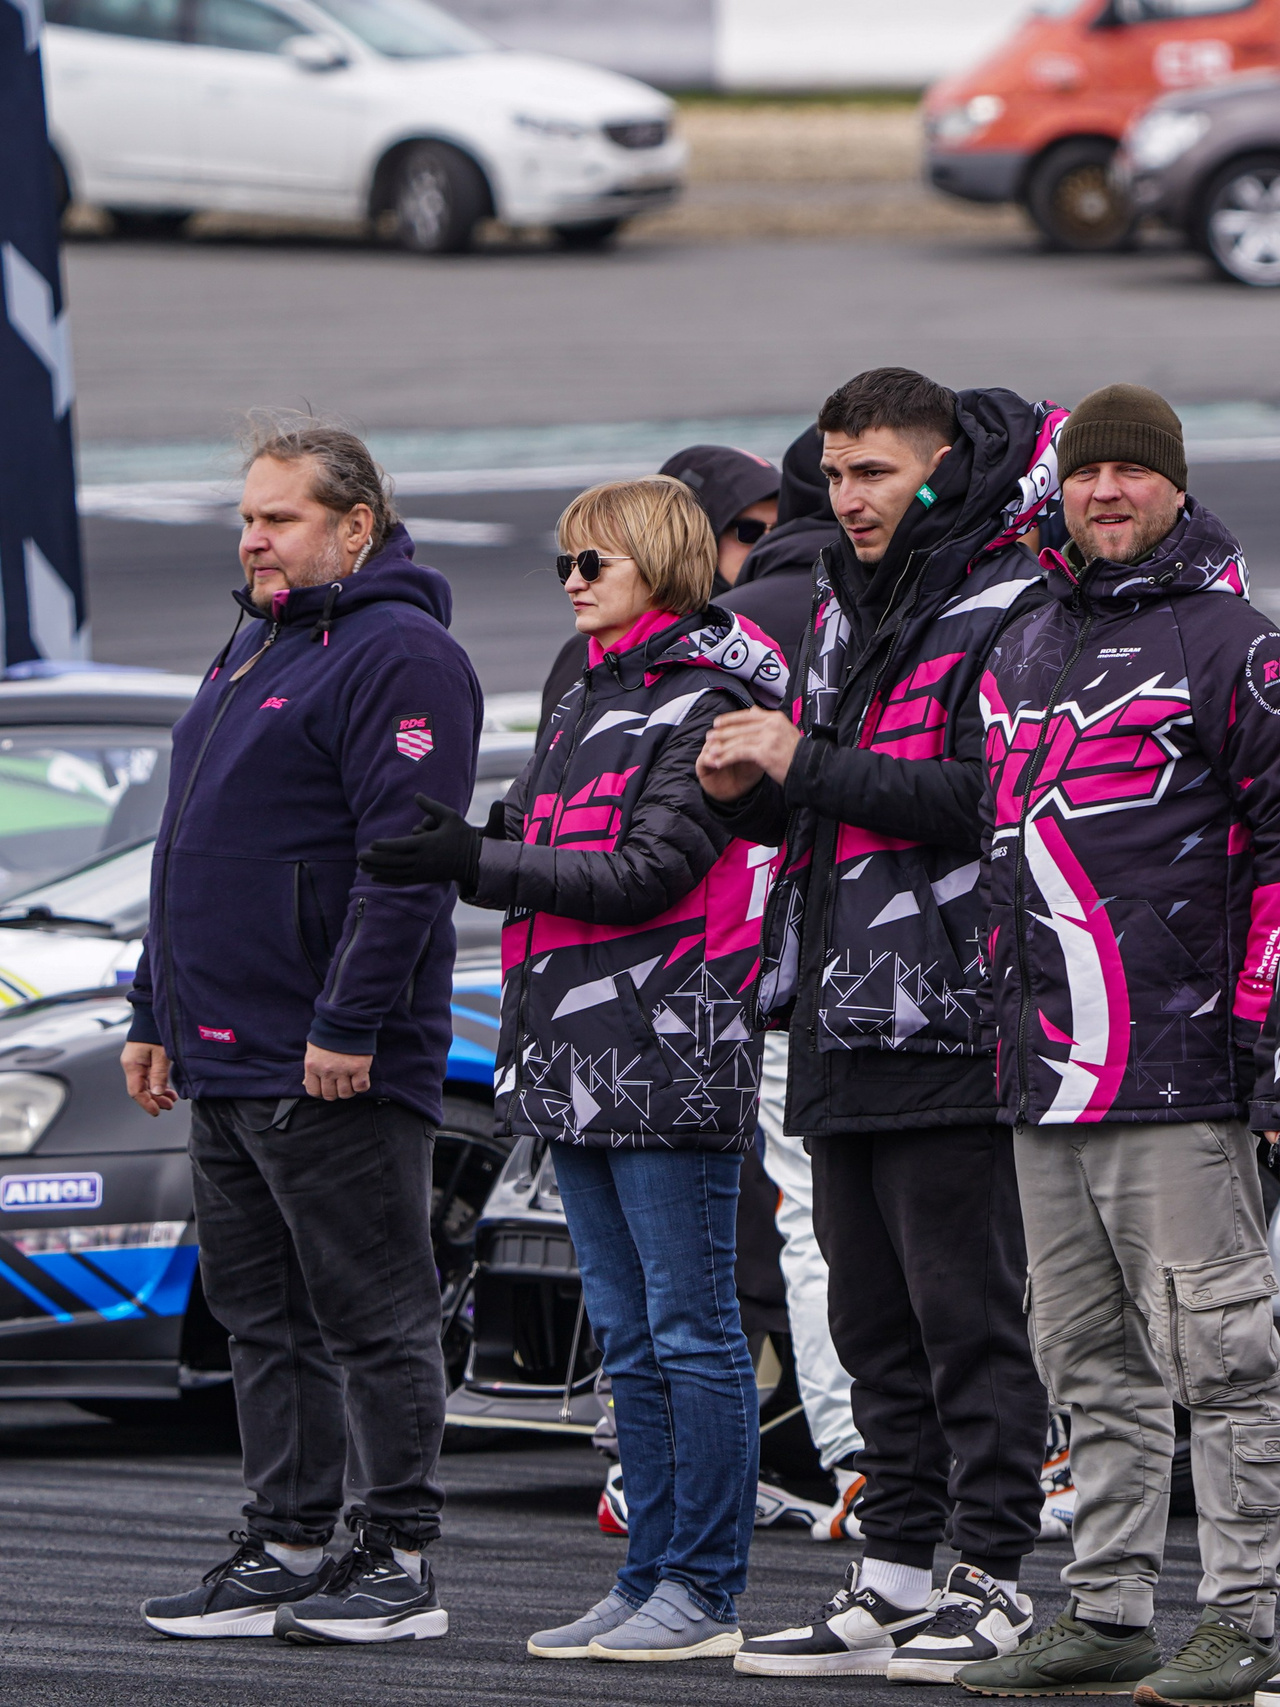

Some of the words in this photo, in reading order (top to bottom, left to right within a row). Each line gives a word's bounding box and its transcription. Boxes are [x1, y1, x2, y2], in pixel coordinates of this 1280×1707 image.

[1245, 646, 1256, 677] OFFICIAL
[1251, 633, 1267, 647] TEAM
[1247, 679, 1260, 700] TEAM
[400, 718, 427, 730] RDS
[5, 1180, 95, 1204] AIMOL
